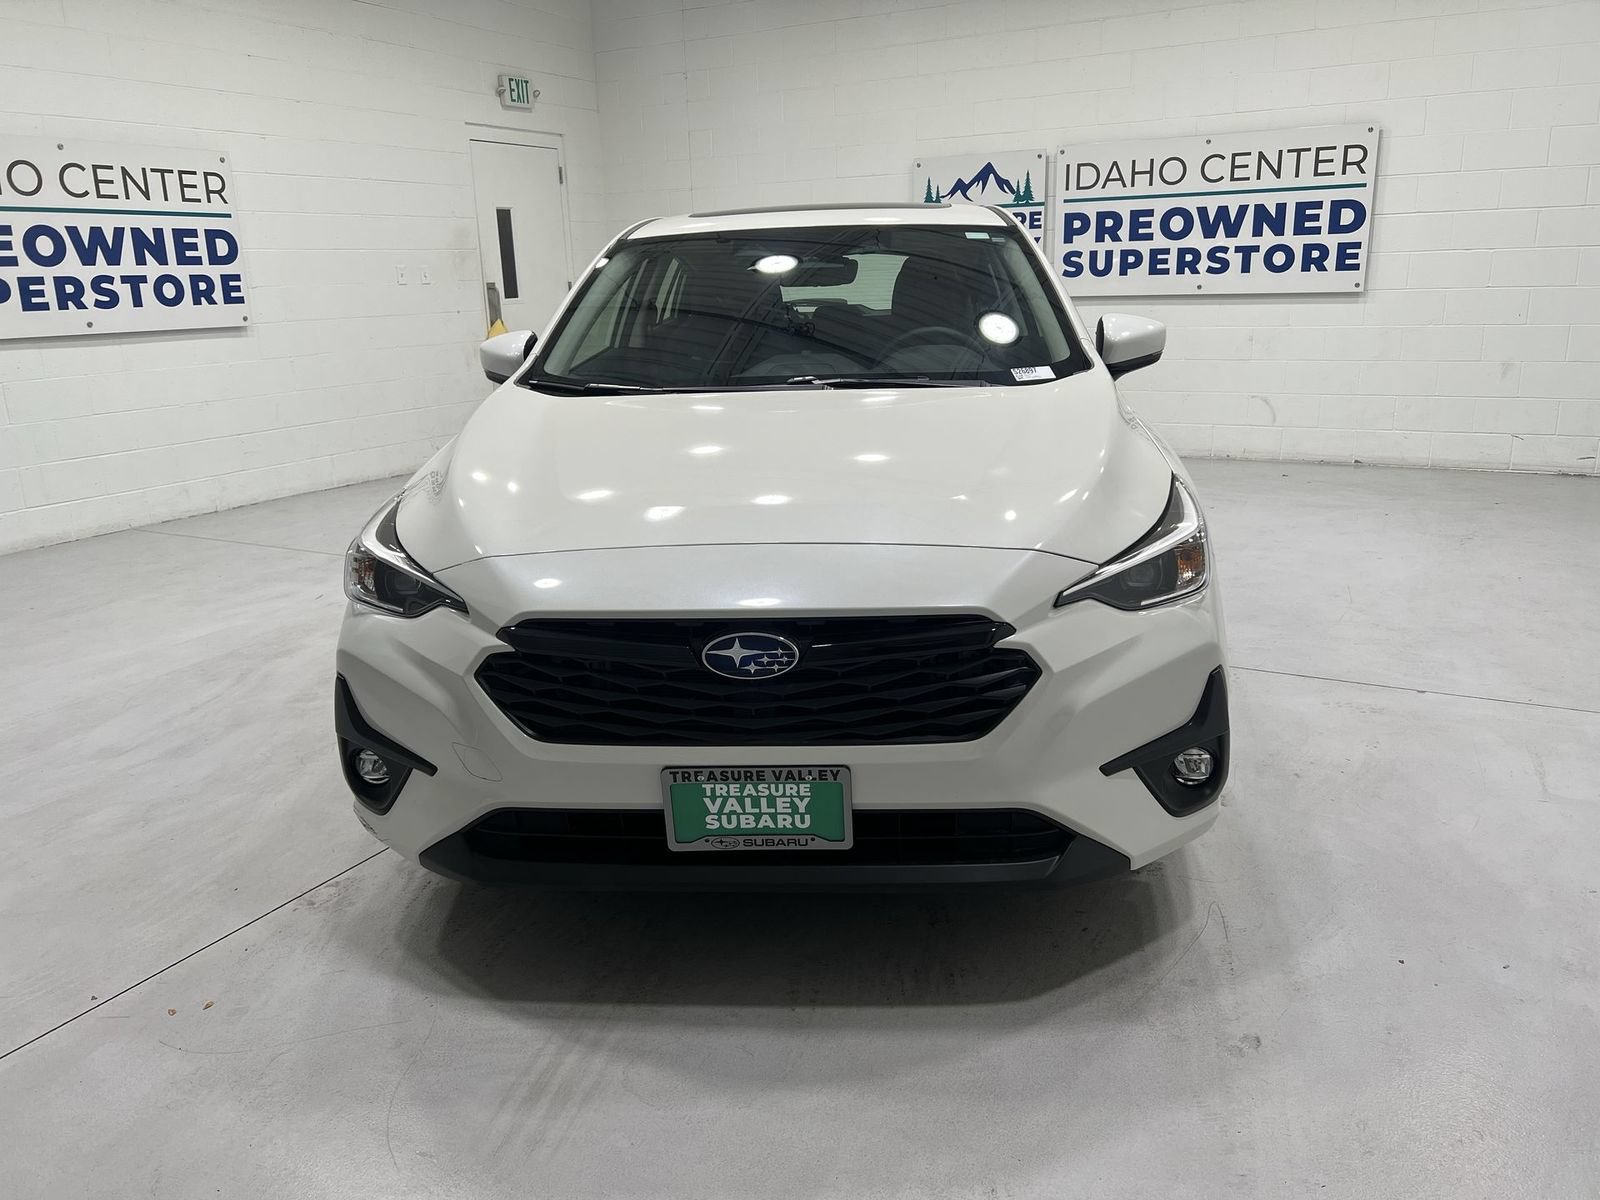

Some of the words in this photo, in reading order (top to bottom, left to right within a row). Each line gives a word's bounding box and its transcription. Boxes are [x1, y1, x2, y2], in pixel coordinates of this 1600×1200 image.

[508, 78, 529, 104] EXIT
[1065, 156, 1187, 191] IDAHO
[1200, 144, 1368, 183] CENTER
[59, 162, 228, 204] CENTER
[1063, 199, 1367, 244] PREOWNED
[1062, 241, 1362, 278] SUPERSTORE
[669, 770, 766, 783] TREASURE
[771, 769, 841, 782] VALLEY
[702, 783, 811, 796] TREASURE
[702, 797, 811, 813] VALLEY
[705, 814, 811, 829] SUBARU
[743, 837, 809, 847] SUBARU
